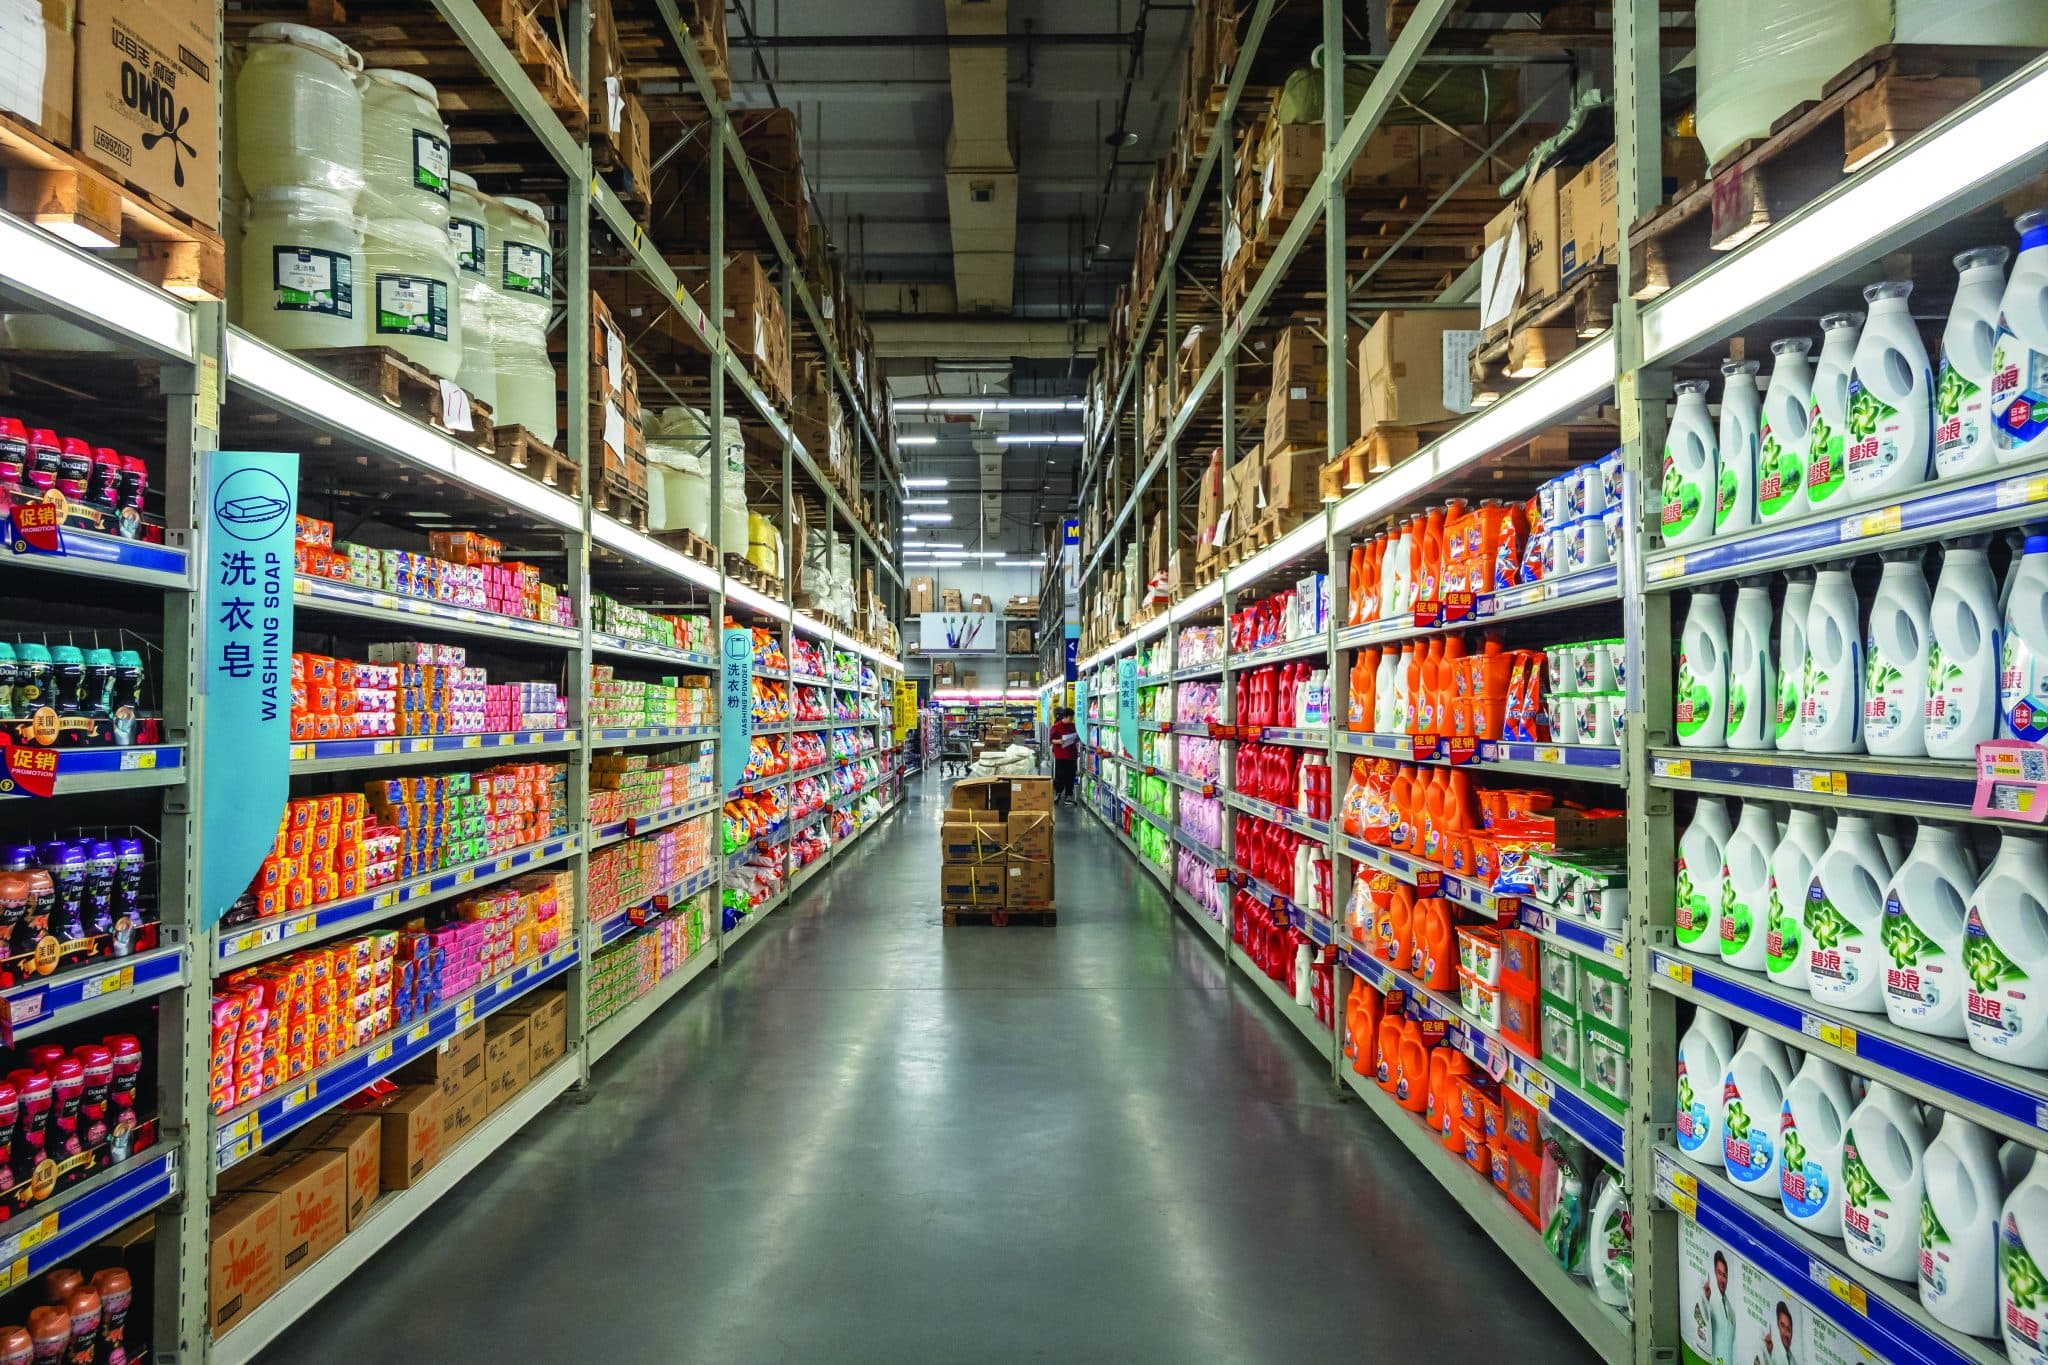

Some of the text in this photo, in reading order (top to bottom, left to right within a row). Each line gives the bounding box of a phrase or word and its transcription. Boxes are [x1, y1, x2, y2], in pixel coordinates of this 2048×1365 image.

[112, 27, 150, 70] 全自动
[121, 61, 175, 132] OMO
[2010, 405, 2028, 416] 日本
[1849, 441, 1879, 463] 碧浪
[20, 506, 55, 527] 促销
[21, 526, 56, 534] PROMOTION
[1416, 602, 1438, 612] 促销
[1447, 593, 1471, 605] 促销
[218, 550, 256, 678] 洗衣皂
[261, 552, 281, 722] WASHING SOAP
[727, 663, 740, 708] 洗衣粉
[37, 715, 55, 728] 美国
[2015, 708, 2028, 718] 日本
[1414, 736, 1436, 746] 促销
[1451, 738, 1474, 748] 促销
[13, 749, 56, 771] 促销
[1998, 753, 2014, 763] 500
[11, 768, 54, 778] PROMOTION
[1810, 950, 1841, 971] 碧浪
[1887, 968, 1920, 992] 碧浪
[1967, 992, 2001, 1020] 碧浪
[1423, 1021, 1444, 1032] 促销
[1845, 1205, 1870, 1234] 碧浪
[1812, 1316, 1827, 1332] NEW
